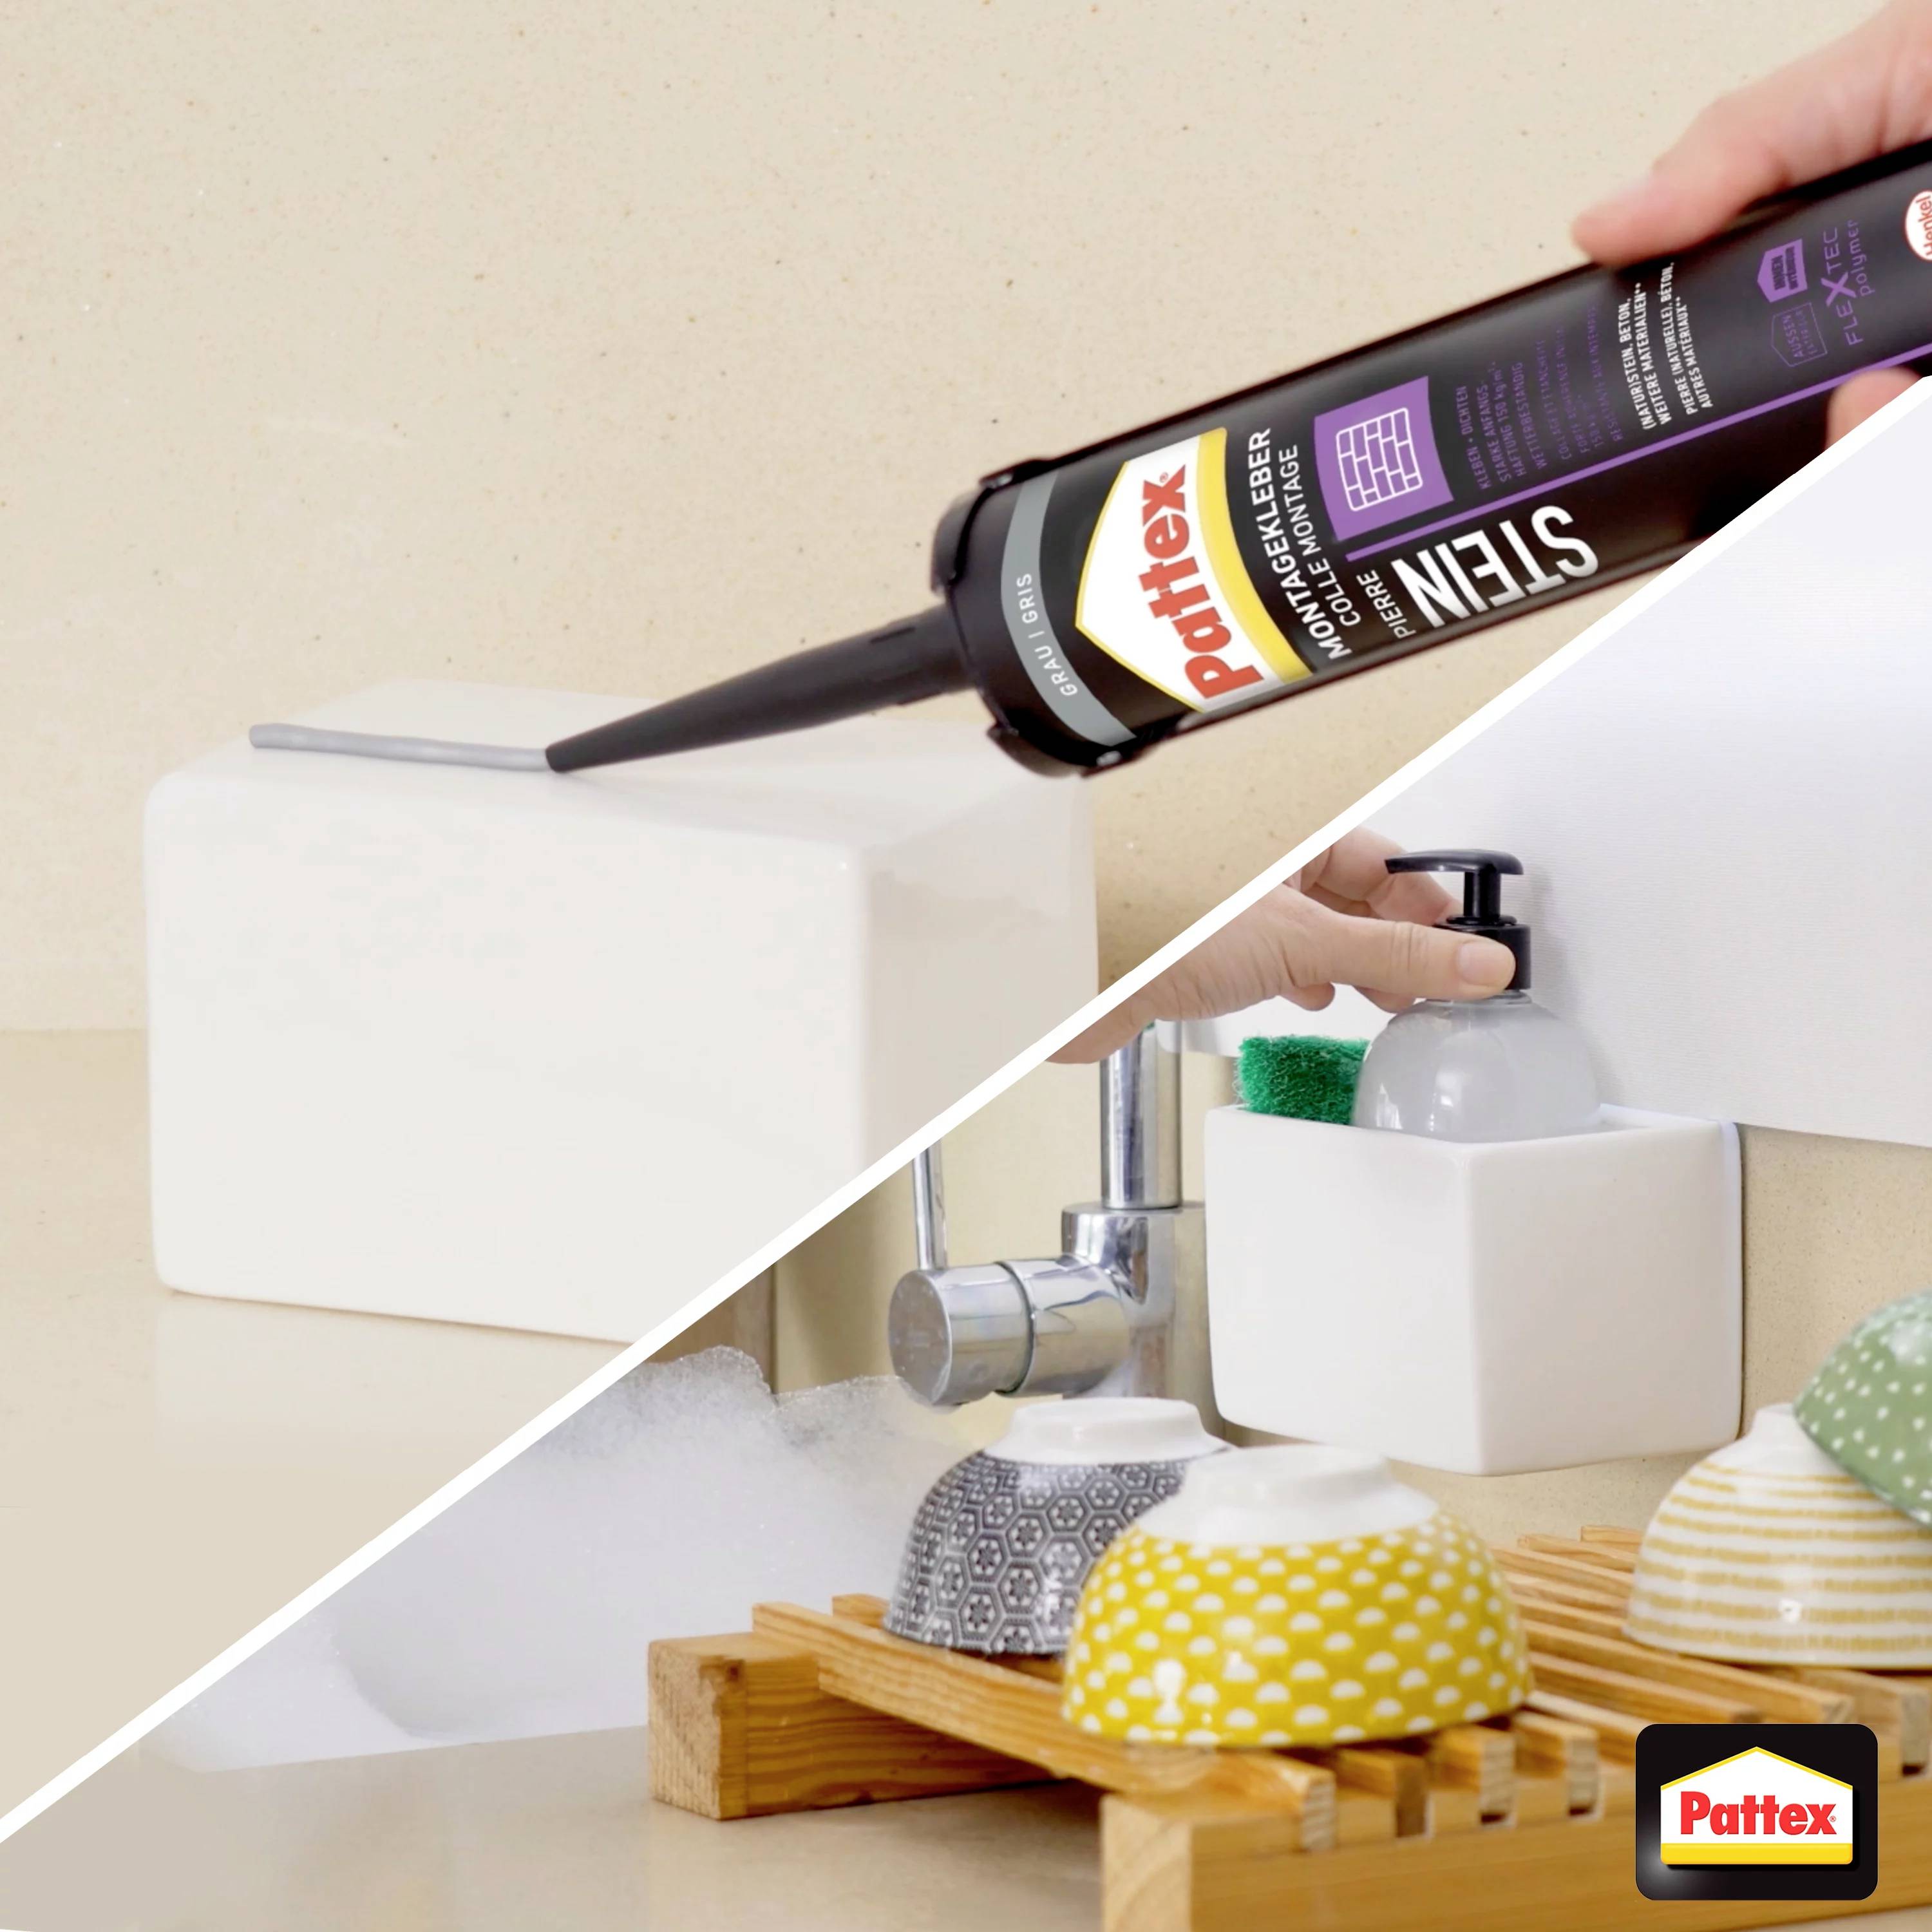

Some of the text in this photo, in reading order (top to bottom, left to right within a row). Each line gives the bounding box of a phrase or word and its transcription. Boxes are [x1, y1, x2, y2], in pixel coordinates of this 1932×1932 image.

[1848, 220, 1875, 296] polymer
[1494, 401, 1508, 422] 150
[1644, 372, 1672, 425] WEITERE
[1674, 375, 1698, 415] PIERRE
[1689, 366, 1713, 408] AUTRES
[1456, 386, 1492, 490] KLEBEN DICHTEN
[1487, 439, 1511, 483] STARKE
[1501, 424, 1527, 477] HAFTUNG
[1248, 428, 1352, 660] MONTAGEKLEBER
[1278, 445, 1361, 628] COLLE MONTAGE
[1390, 505, 1598, 629] STEIN
[1139, 465, 1265, 699] Pattex
[1356, 569, 1416, 639] PIERRE
[1016, 573, 1078, 696] GRAU GRIS
